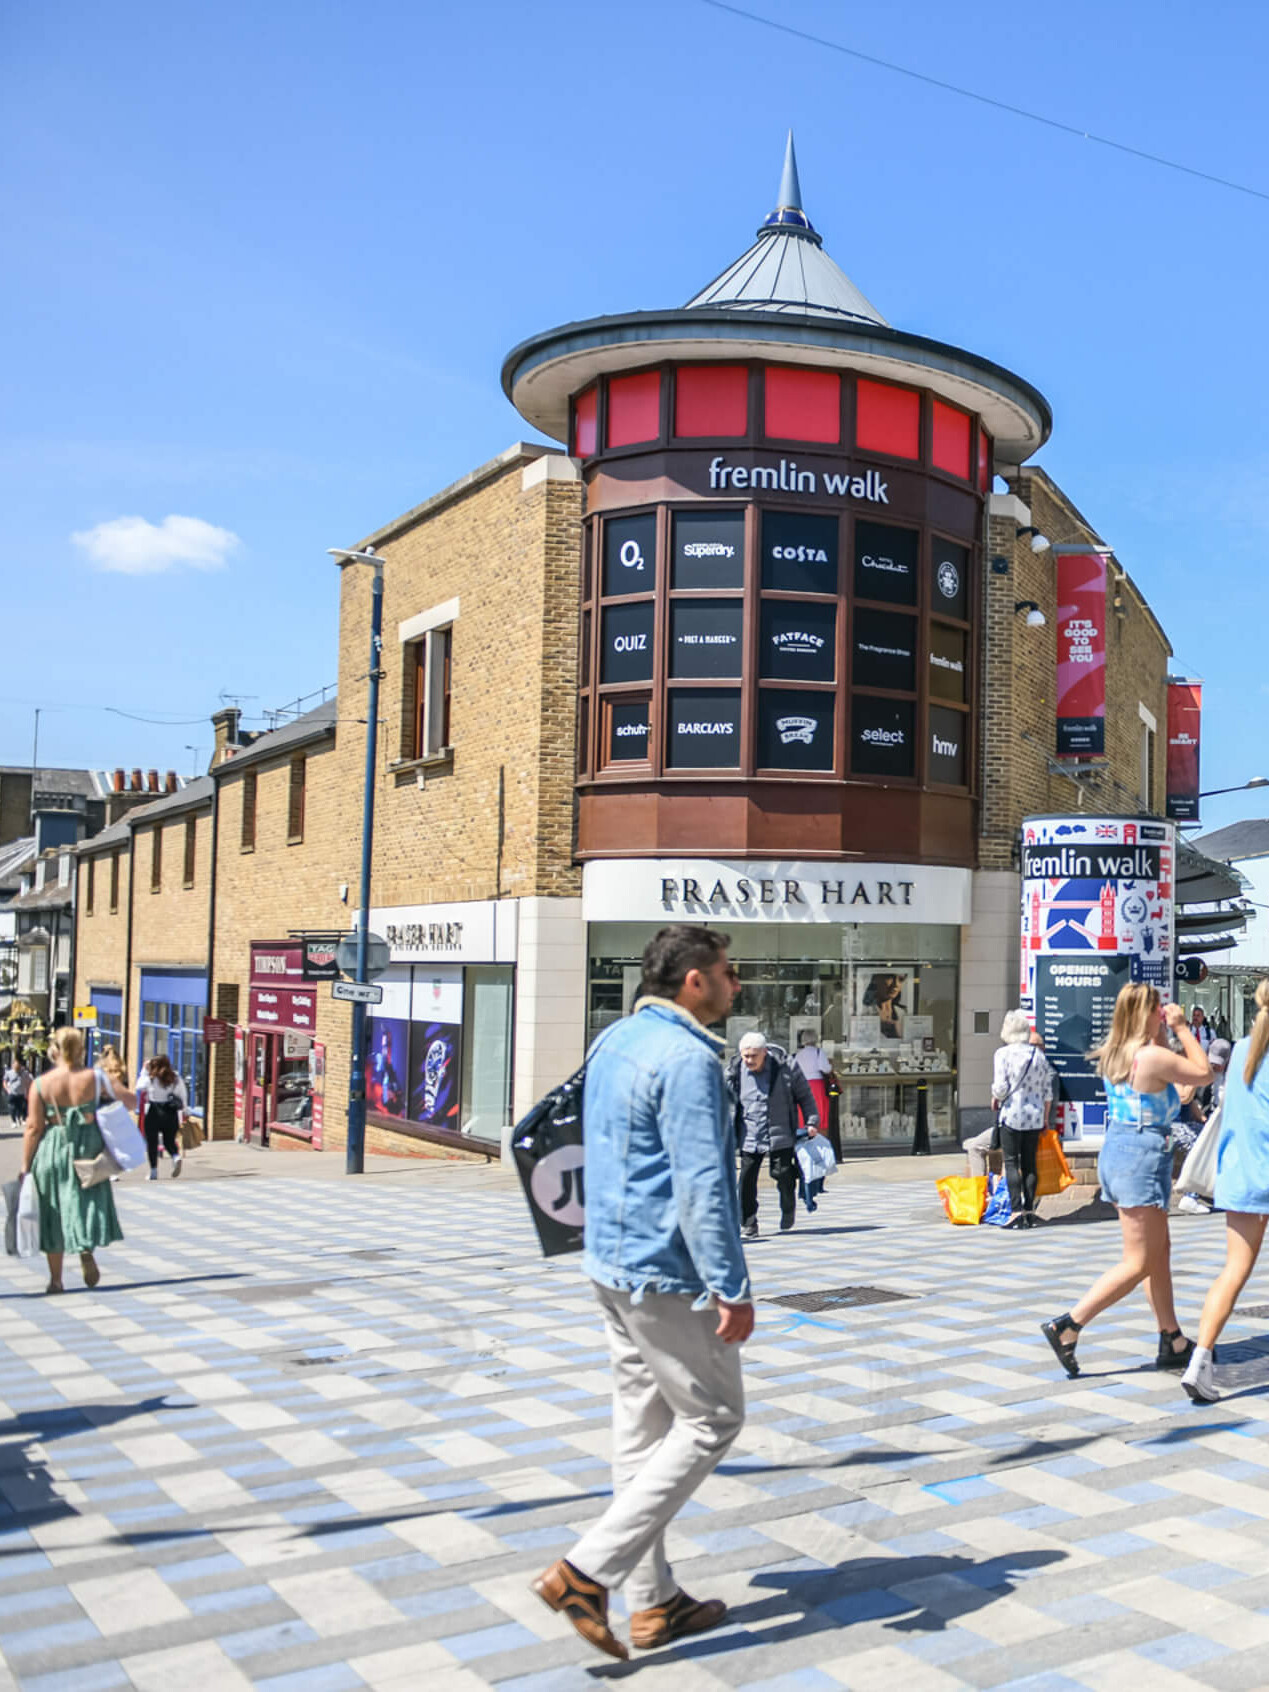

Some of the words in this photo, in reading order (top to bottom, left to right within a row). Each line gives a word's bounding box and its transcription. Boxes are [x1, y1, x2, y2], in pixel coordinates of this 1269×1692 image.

[709, 457, 815, 493] fremlin
[823, 470, 889, 504] walk
[772, 545, 828, 562] COSTA
[772, 631, 825, 648] FATFACE
[1064, 628, 1098, 637] GOOD
[614, 634, 647, 652] QUIZ
[1072, 637, 1089, 645] TO
[1069, 654, 1093, 662] YOU
[677, 722, 733, 734] BARCLAYS
[861, 728, 904, 743] select
[933, 734, 957, 757] hmv
[1024, 848, 1091, 876] fremlin
[1098, 849, 1153, 876] walk
[660, 878, 805, 904] FRASER
[822, 880, 916, 905] HART
[1049, 964, 1109, 975] OPENING
[1055, 976, 1102, 987] HOURS
